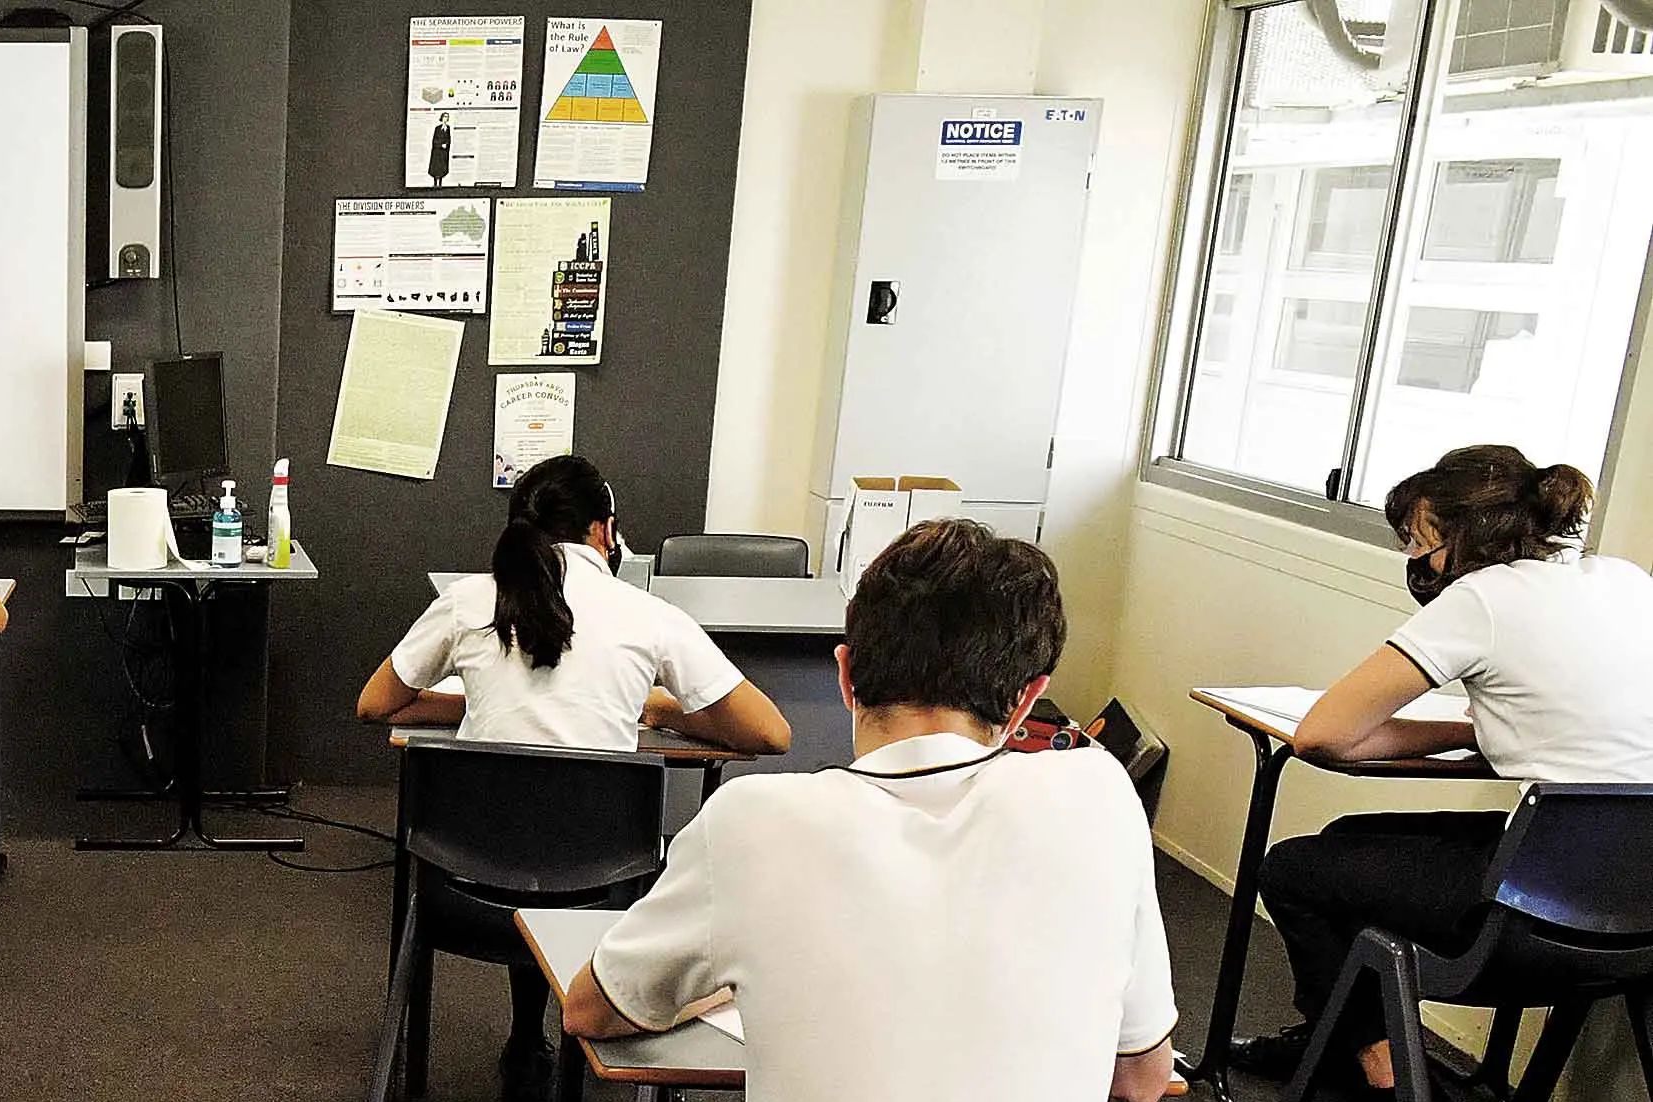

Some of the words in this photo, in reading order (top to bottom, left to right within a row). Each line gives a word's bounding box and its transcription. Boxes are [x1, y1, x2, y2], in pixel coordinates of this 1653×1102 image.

[428, 18, 476, 26] SEPARATION
[477, 18, 487, 26] OF
[488, 18, 522, 26] POWERS
[550, 20, 575, 30] What
[577, 21, 586, 30] is
[550, 33, 566, 42] the
[568, 33, 589, 42] Rule
[549, 44, 560, 53] of
[561, 44, 585, 53] Law?
[946, 123, 1016, 139] NOTICE
[352, 201, 384, 211] DIVISION
[384, 201, 393, 211] OF
[395, 201, 425, 211] POWERS
